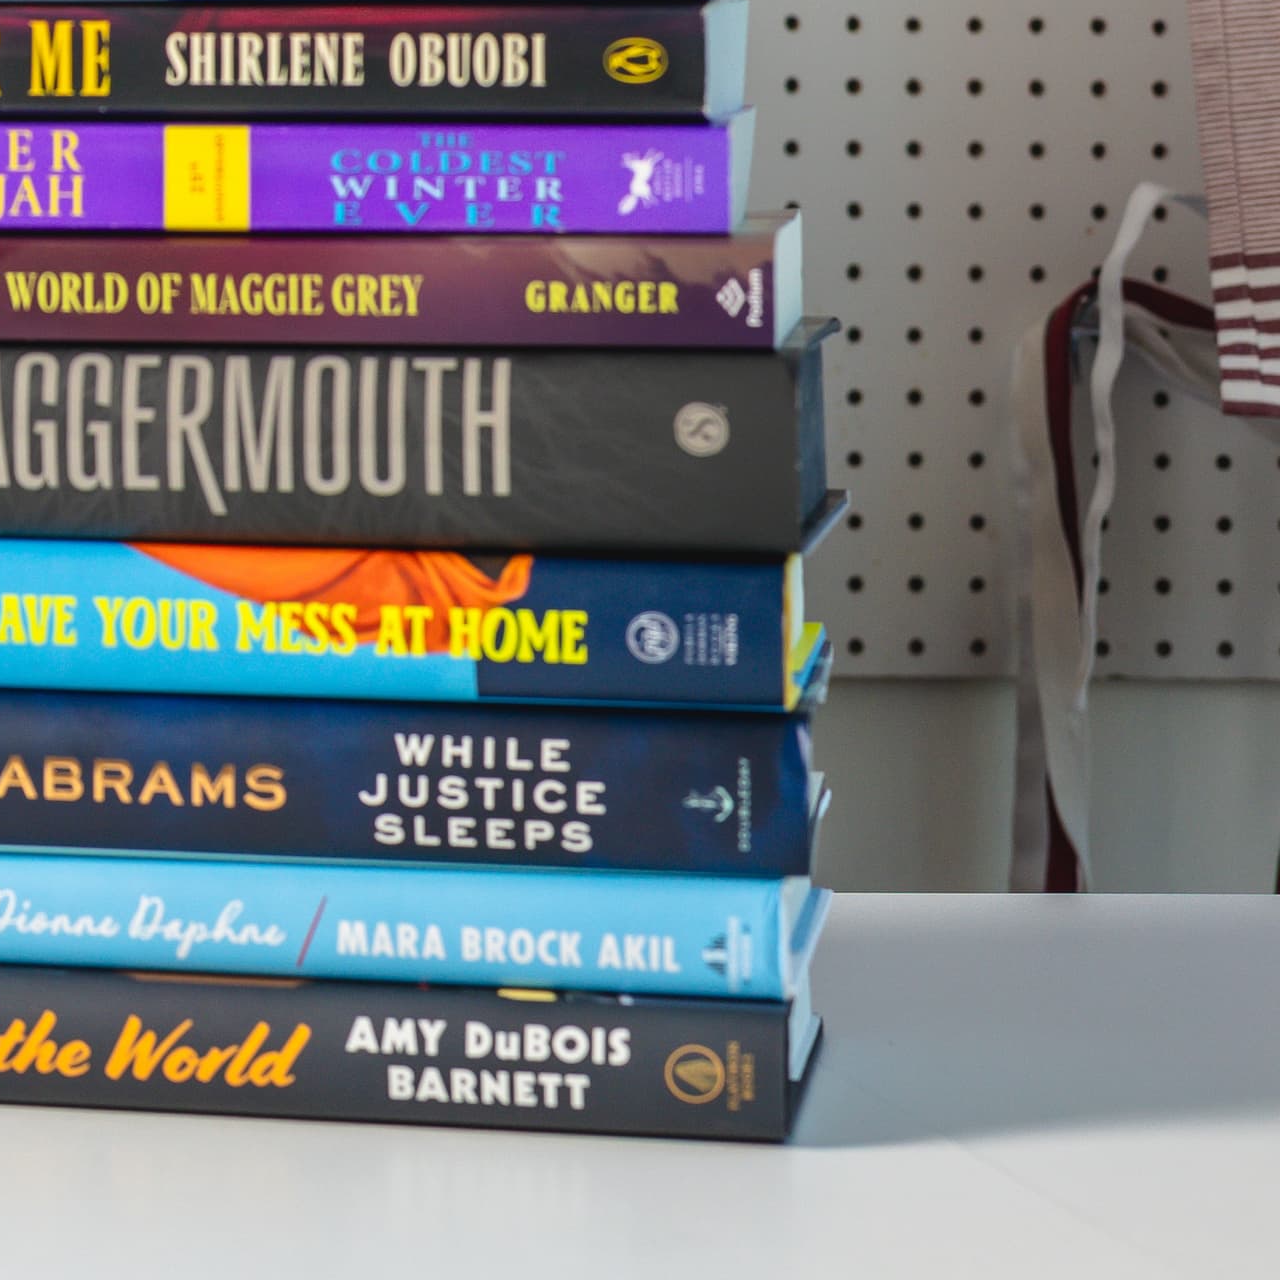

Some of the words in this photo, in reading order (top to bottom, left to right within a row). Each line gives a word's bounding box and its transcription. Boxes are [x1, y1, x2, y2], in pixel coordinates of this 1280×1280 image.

[28, 20, 111, 97] ME
[165, 32, 364, 87] SHIRLENE
[389, 32, 546, 87] OBUOBI
[329, 149, 566, 175] COLDEST
[420, 133, 472, 148] THE
[329, 175, 564, 201] WINTER
[334, 201, 564, 228] EVER
[6, 272, 129, 313] WORLD
[137, 273, 182, 314] OF
[191, 273, 324, 316] MAGGIE
[331, 274, 422, 317] GREY
[525, 281, 679, 314] GRANGER
[747, 268, 763, 328] Podium
[95, 597, 219, 652] YOUR
[237, 602, 357, 657] MESS
[374, 605, 431, 657] AT
[448, 607, 589, 665] HOME
[394, 733, 571, 773] WHILE
[358, 774, 606, 816] JUSTICE
[373, 815, 594, 853] SLEEPS
[129, 897, 288, 958] Daphne
[337, 921, 446, 960] MARA
[461, 927, 581, 968] BROCK
[598, 933, 679, 973] AKIL
[104, 1014, 312, 1088] World
[345, 1016, 447, 1056] AMY
[464, 1021, 631, 1067] DuBOIS
[388, 1066, 590, 1111] BARNETT
